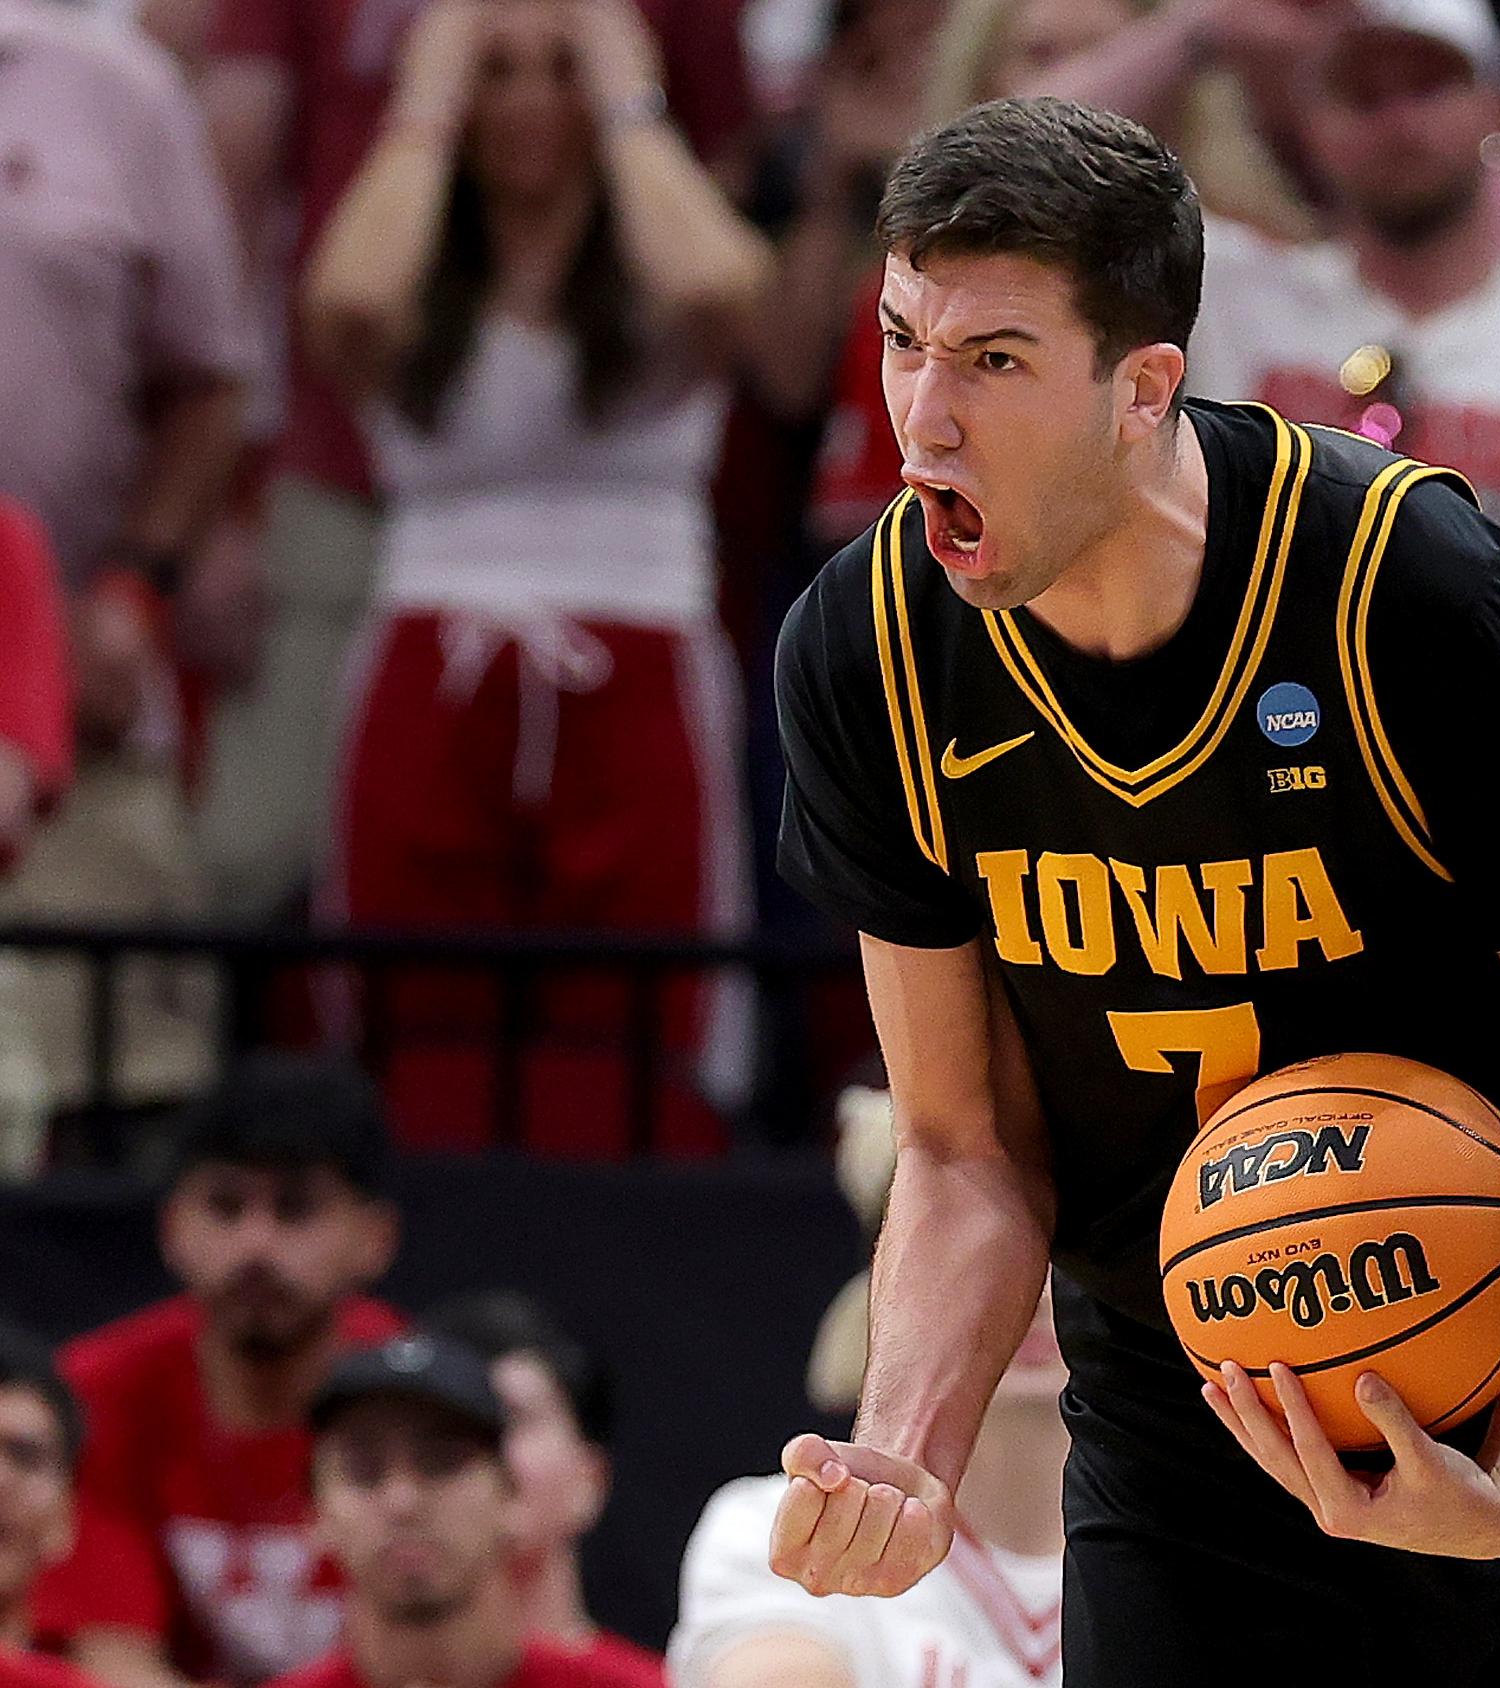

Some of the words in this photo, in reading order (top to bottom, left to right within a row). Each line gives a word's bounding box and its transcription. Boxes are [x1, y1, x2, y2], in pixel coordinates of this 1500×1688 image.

[1266, 711, 1317, 732] NCAA
[976, 847, 1364, 981] IOWA
[1106, 1001, 1260, 1128] 7
[1293, 1112, 1374, 1124] OFFICIAL
[1197, 1124, 1373, 1213] NCAA
[1246, 1248, 1280, 1266] NXT
[1285, 1238, 1321, 1256] EVO
[1186, 1231, 1441, 1329] Wilson
